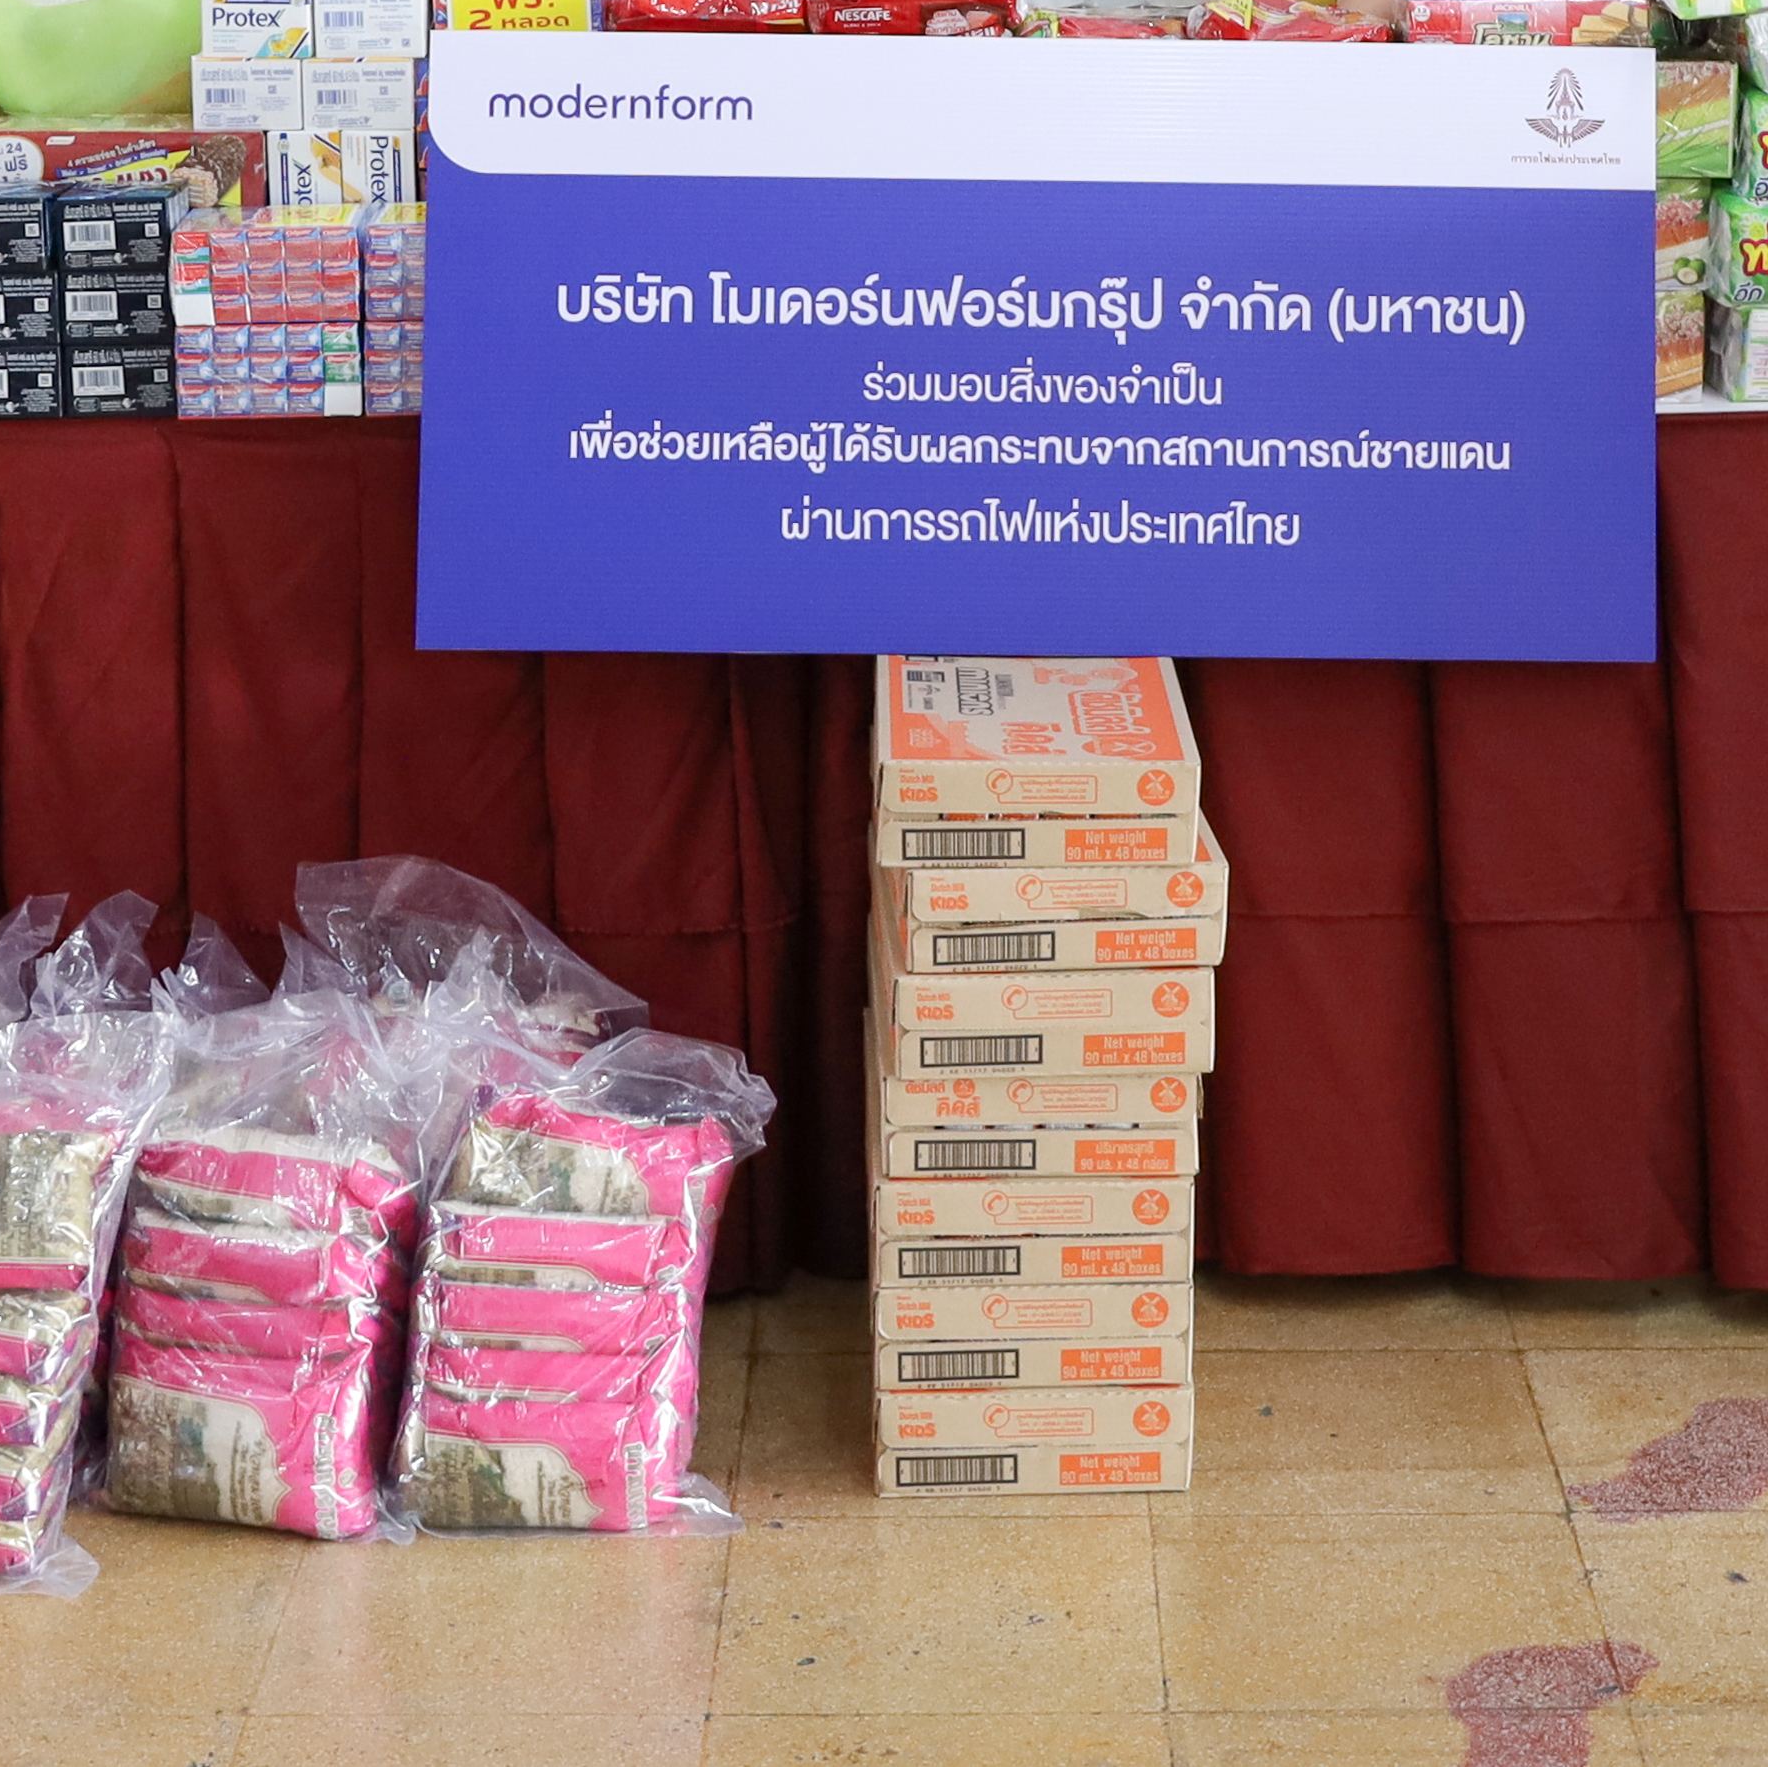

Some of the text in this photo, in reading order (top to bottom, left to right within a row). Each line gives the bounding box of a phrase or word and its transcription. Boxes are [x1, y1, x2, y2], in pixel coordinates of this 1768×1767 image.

[212, 7, 285, 28] Protex
[502, 15, 570, 29] หลอด
[488, 83, 754, 122] modernform
[5, 143, 22, 154] 24
[4, 155, 28, 172] ฟรี
[1511, 151, 1622, 167] การรถไฟแห่งประเทศไทย
[370, 135, 389, 205] Protex
[557, 270, 1526, 344] บริษัท โมเดอร์นฟอร์มกรุ๊ป จำกัด (มหาชน)
[864, 355, 1223, 407] ร่วมมอบสิ่งของจำเป็น
[570, 410, 1511, 477] เพื่อช่วยเหลือผู้ได้รับผลกระทบจากสถานการณ์ชายแดน
[782, 494, 1301, 549] ผ่านการรถไฟแห่งประเทศไทย
[899, 786, 938, 803] KIDS
[1085, 832, 1147, 846] Net weight
[1066, 847, 1081, 861] 90
[1116, 847, 1130, 859] 48
[1133, 845, 1166, 859] boxes
[930, 895, 969, 911] KIDS
